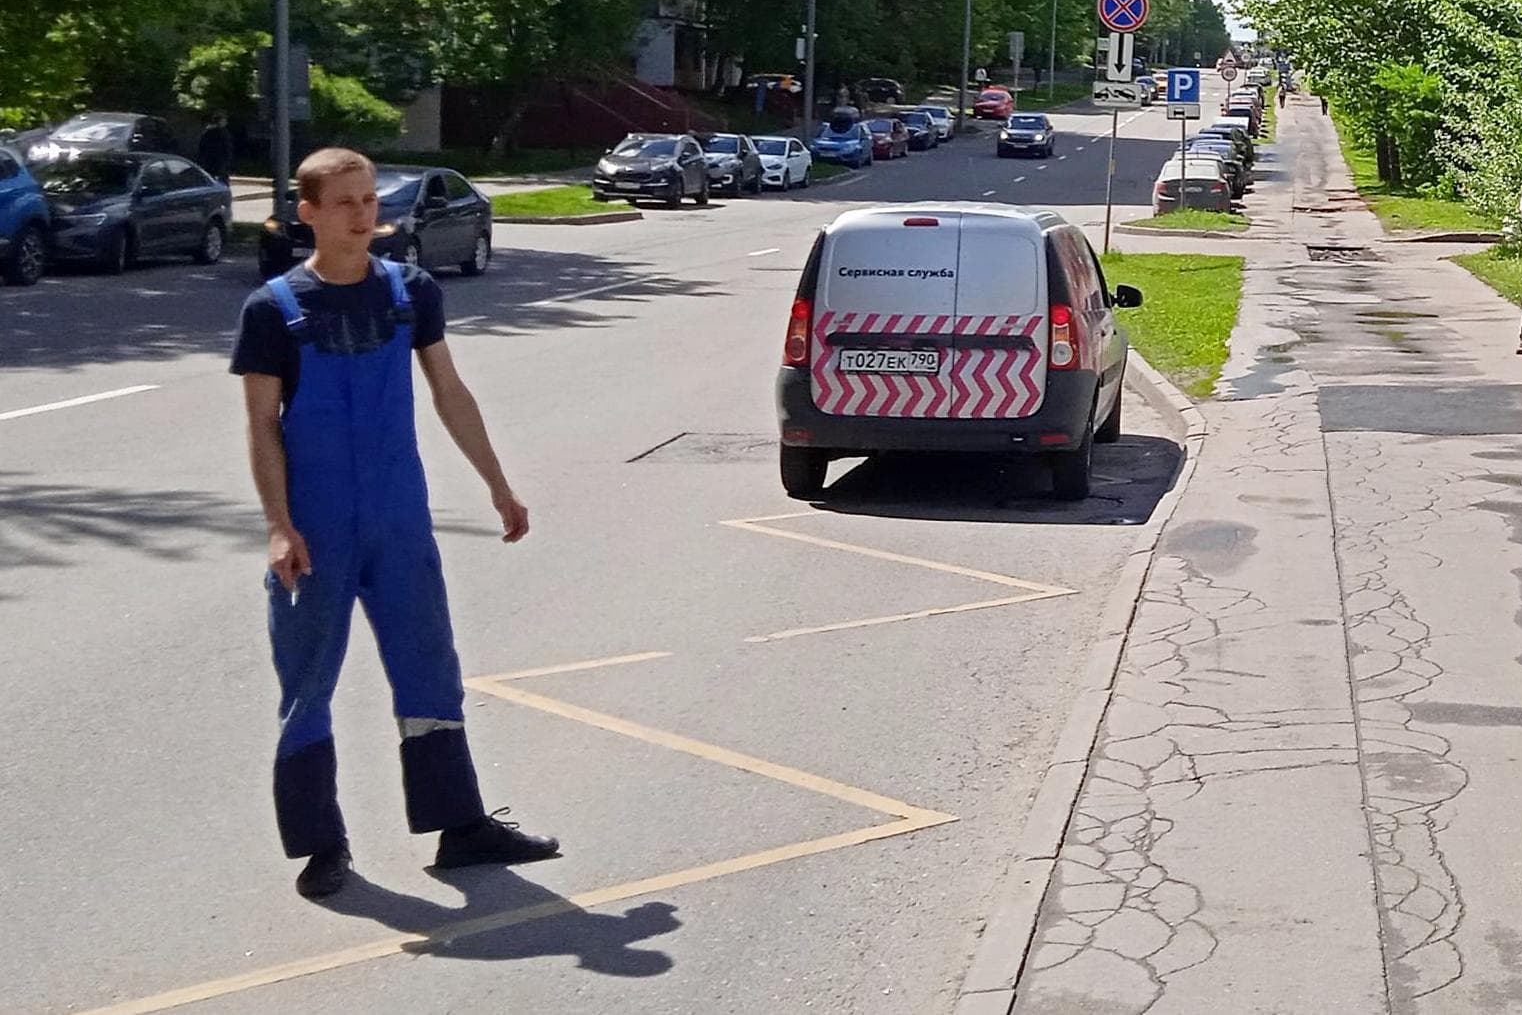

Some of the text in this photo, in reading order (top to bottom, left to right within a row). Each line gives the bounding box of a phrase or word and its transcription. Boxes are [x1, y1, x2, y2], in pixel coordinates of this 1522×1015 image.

[1174, 73, 1193, 99] P
[839, 267, 955, 279] Сервисная служба
[911, 353, 936, 365] 790
